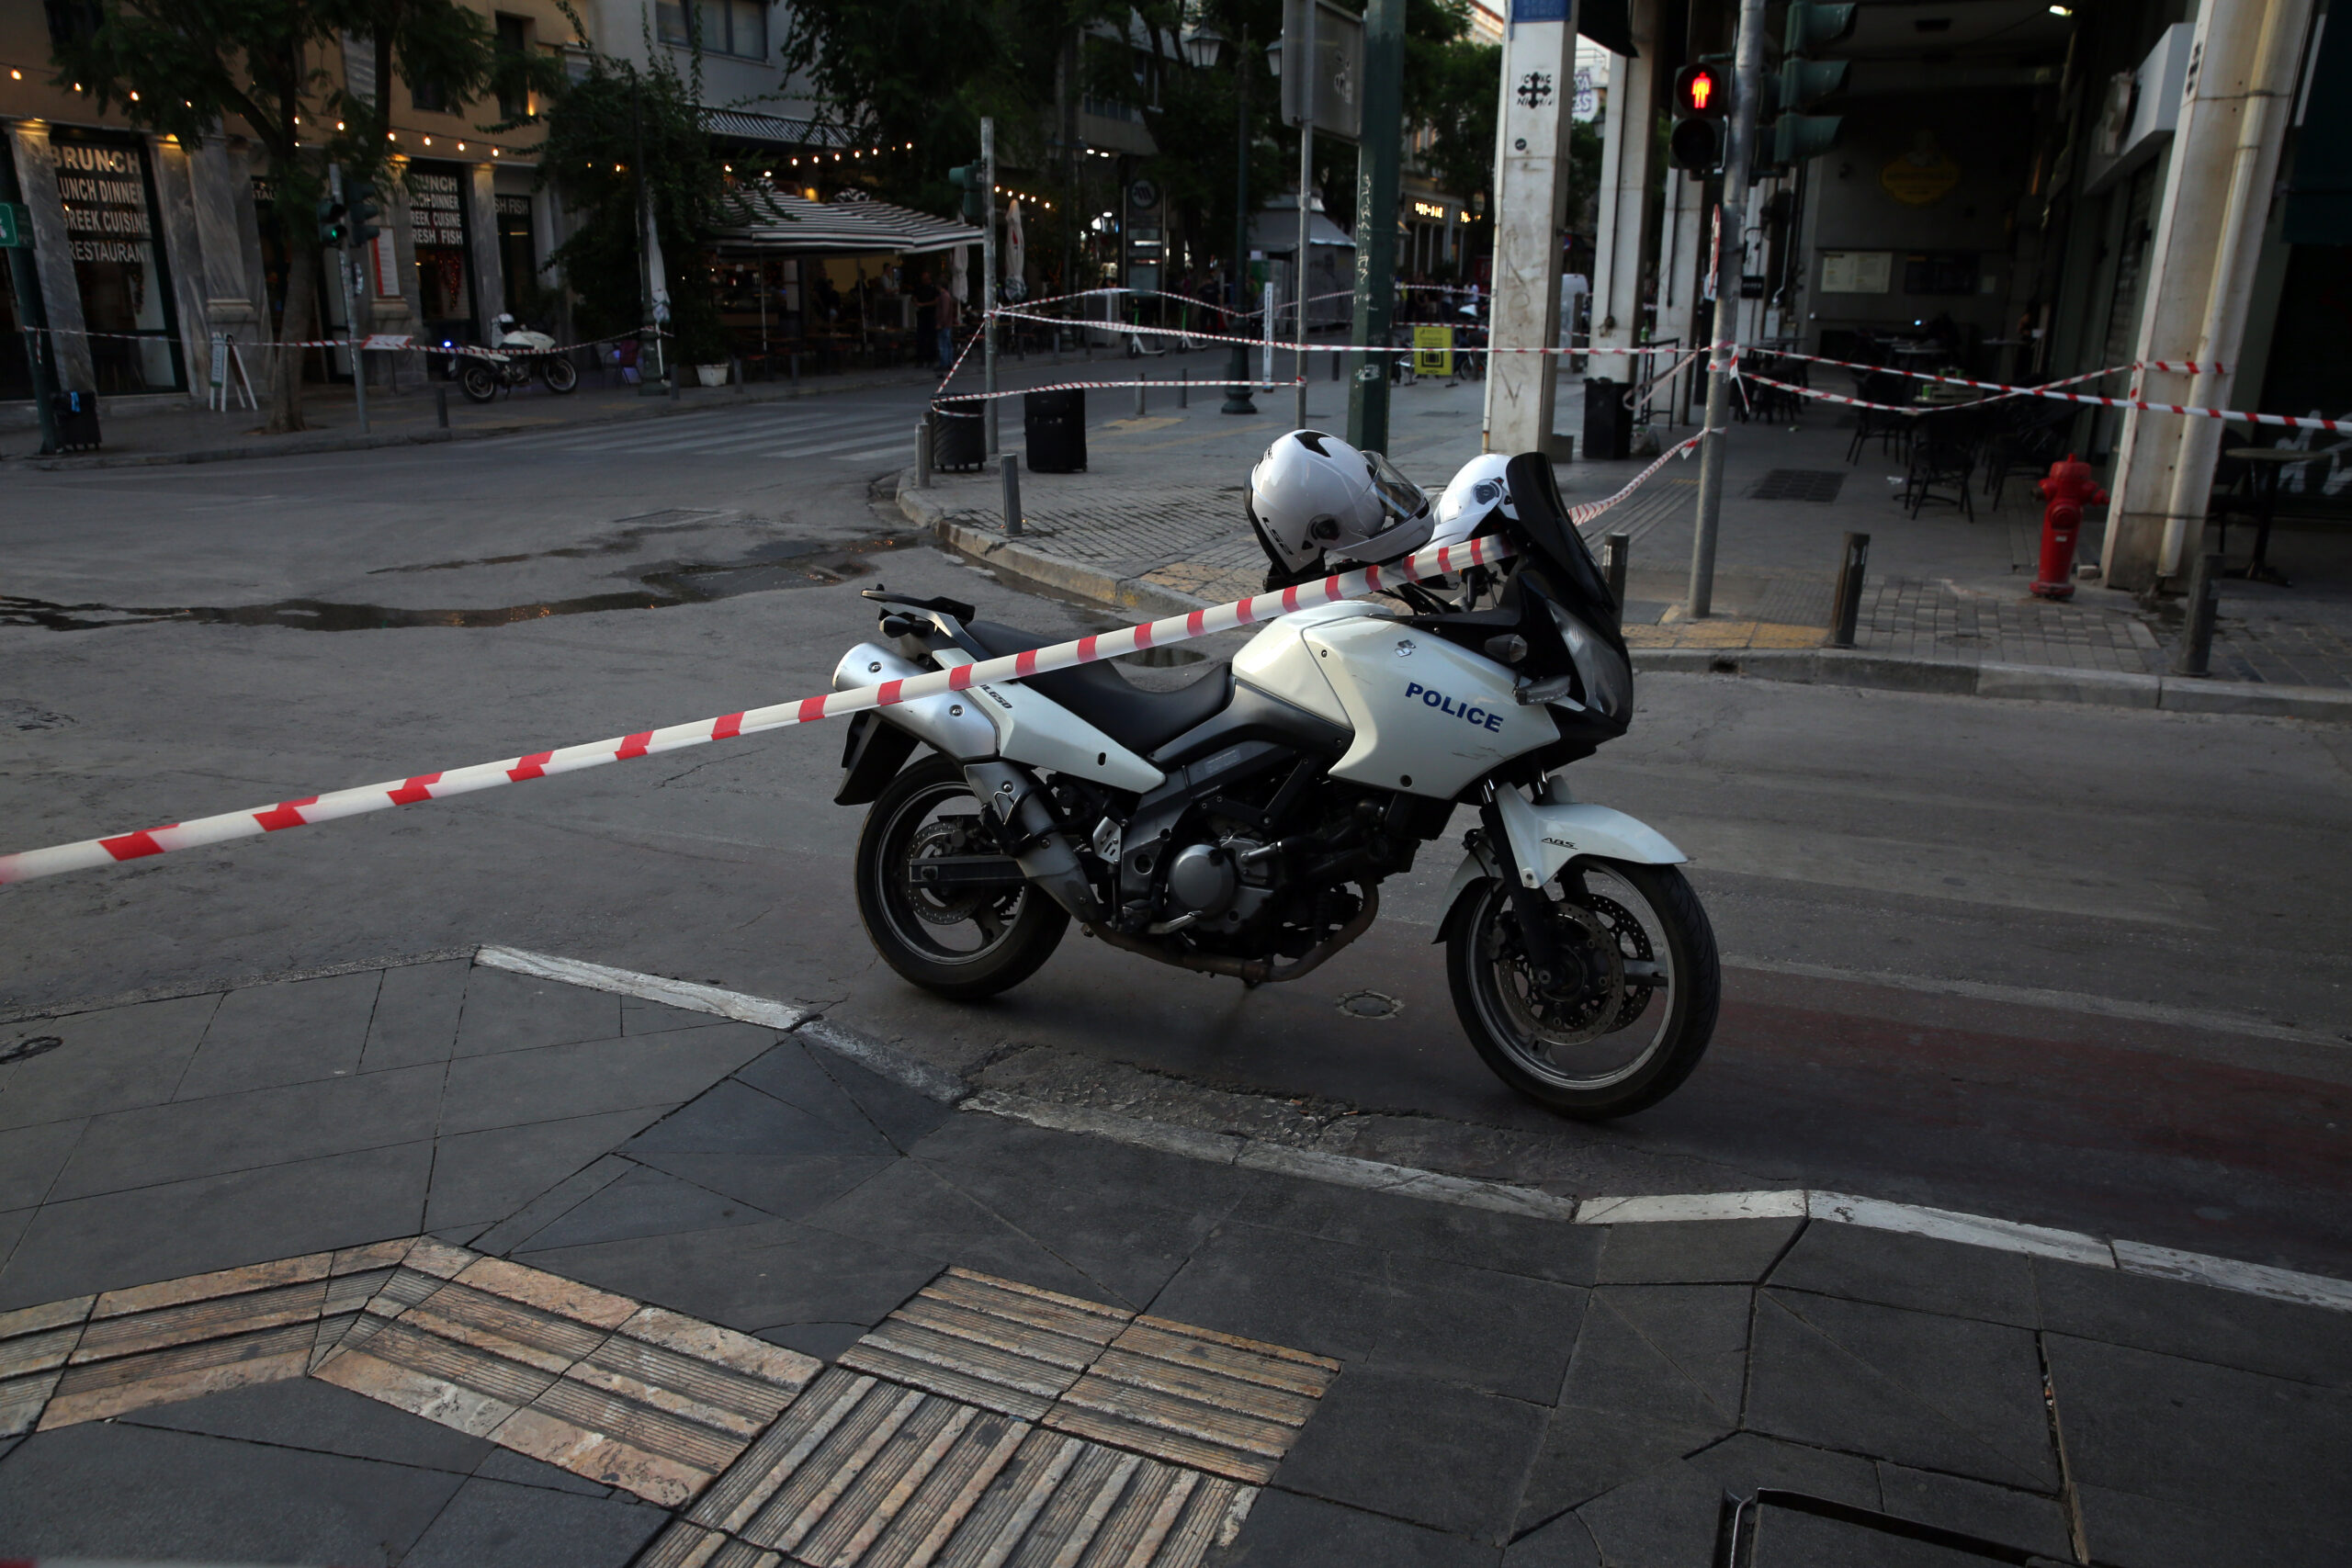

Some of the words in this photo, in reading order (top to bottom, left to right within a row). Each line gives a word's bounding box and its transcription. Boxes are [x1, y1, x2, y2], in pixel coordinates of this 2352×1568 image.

[50, 145, 141, 175] BRUNCH
[59, 176, 97, 202] UNCH
[98, 179, 147, 205] DINNER
[411, 174, 458, 193] RUNCH
[431, 194, 460, 209] DINNER
[508, 197, 529, 215] FISH
[103, 210, 152, 234] CUISINE
[410, 210, 431, 226] REEK
[433, 211, 461, 228] CUISINE
[412, 228, 436, 244] RESH
[441, 230, 464, 245] FISH
[1405, 682, 1504, 733] POLICE
[1541, 837, 1577, 849] ABS
